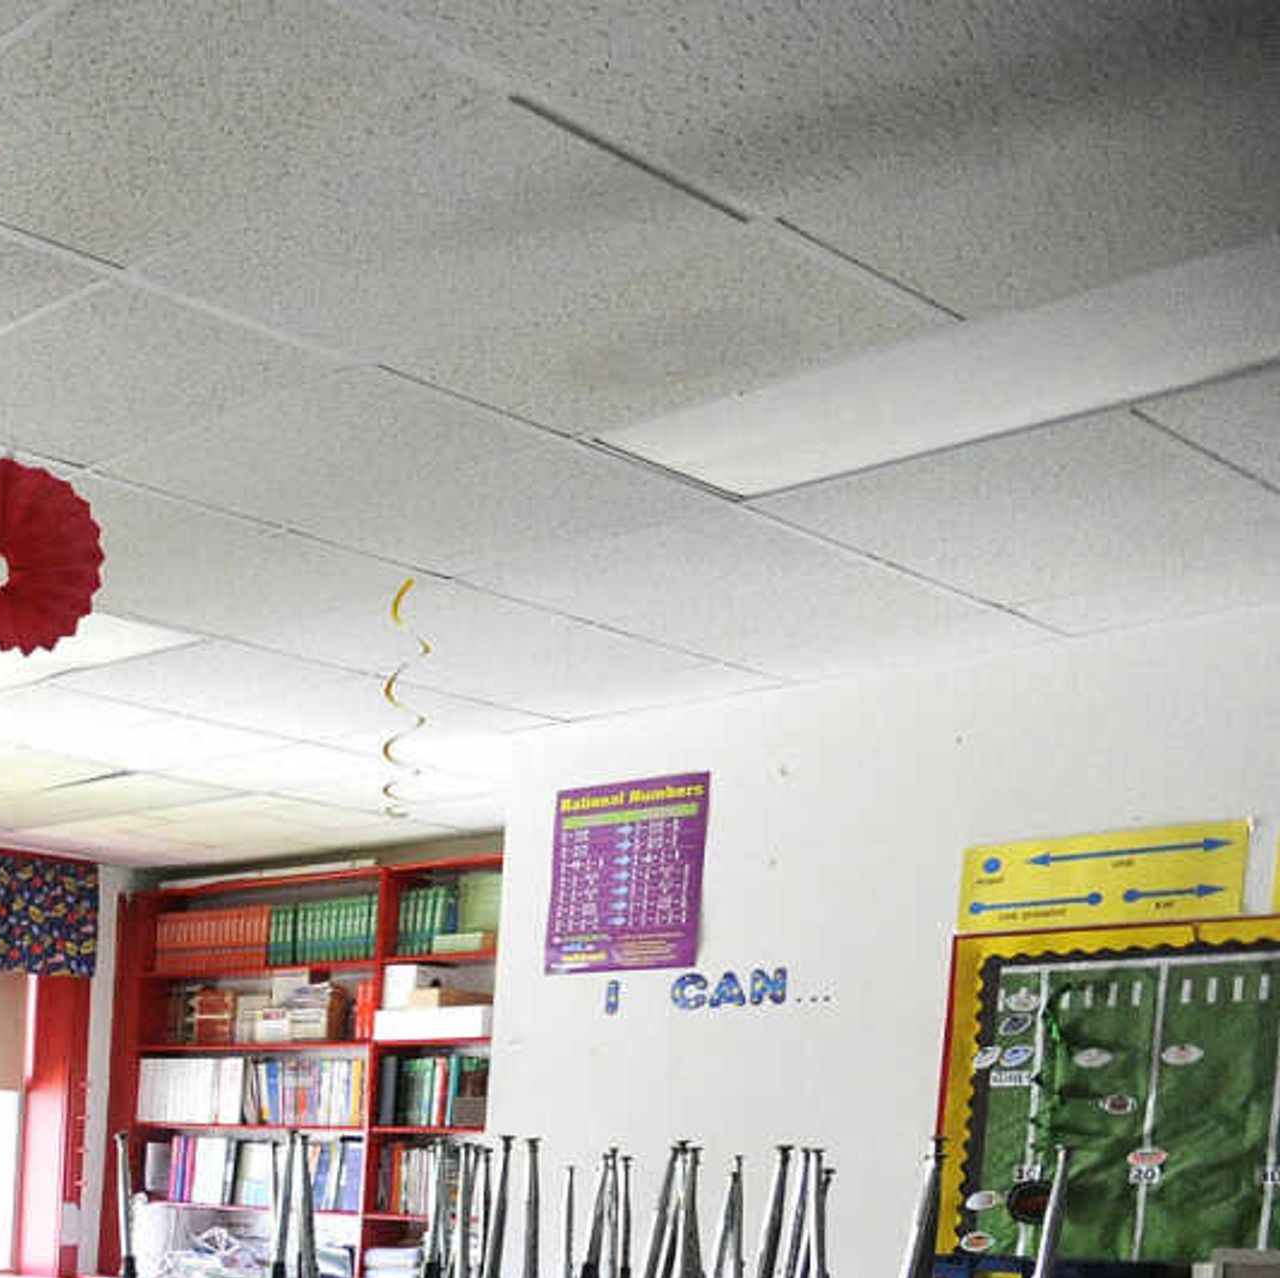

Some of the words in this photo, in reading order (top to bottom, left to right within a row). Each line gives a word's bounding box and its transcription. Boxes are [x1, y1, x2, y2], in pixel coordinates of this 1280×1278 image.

[560, 790, 623, 812] Rational
[629, 784, 705, 804] Numbers
[606, 979, 621, 1015] I
[1133, 1168, 1156, 1180] 20
